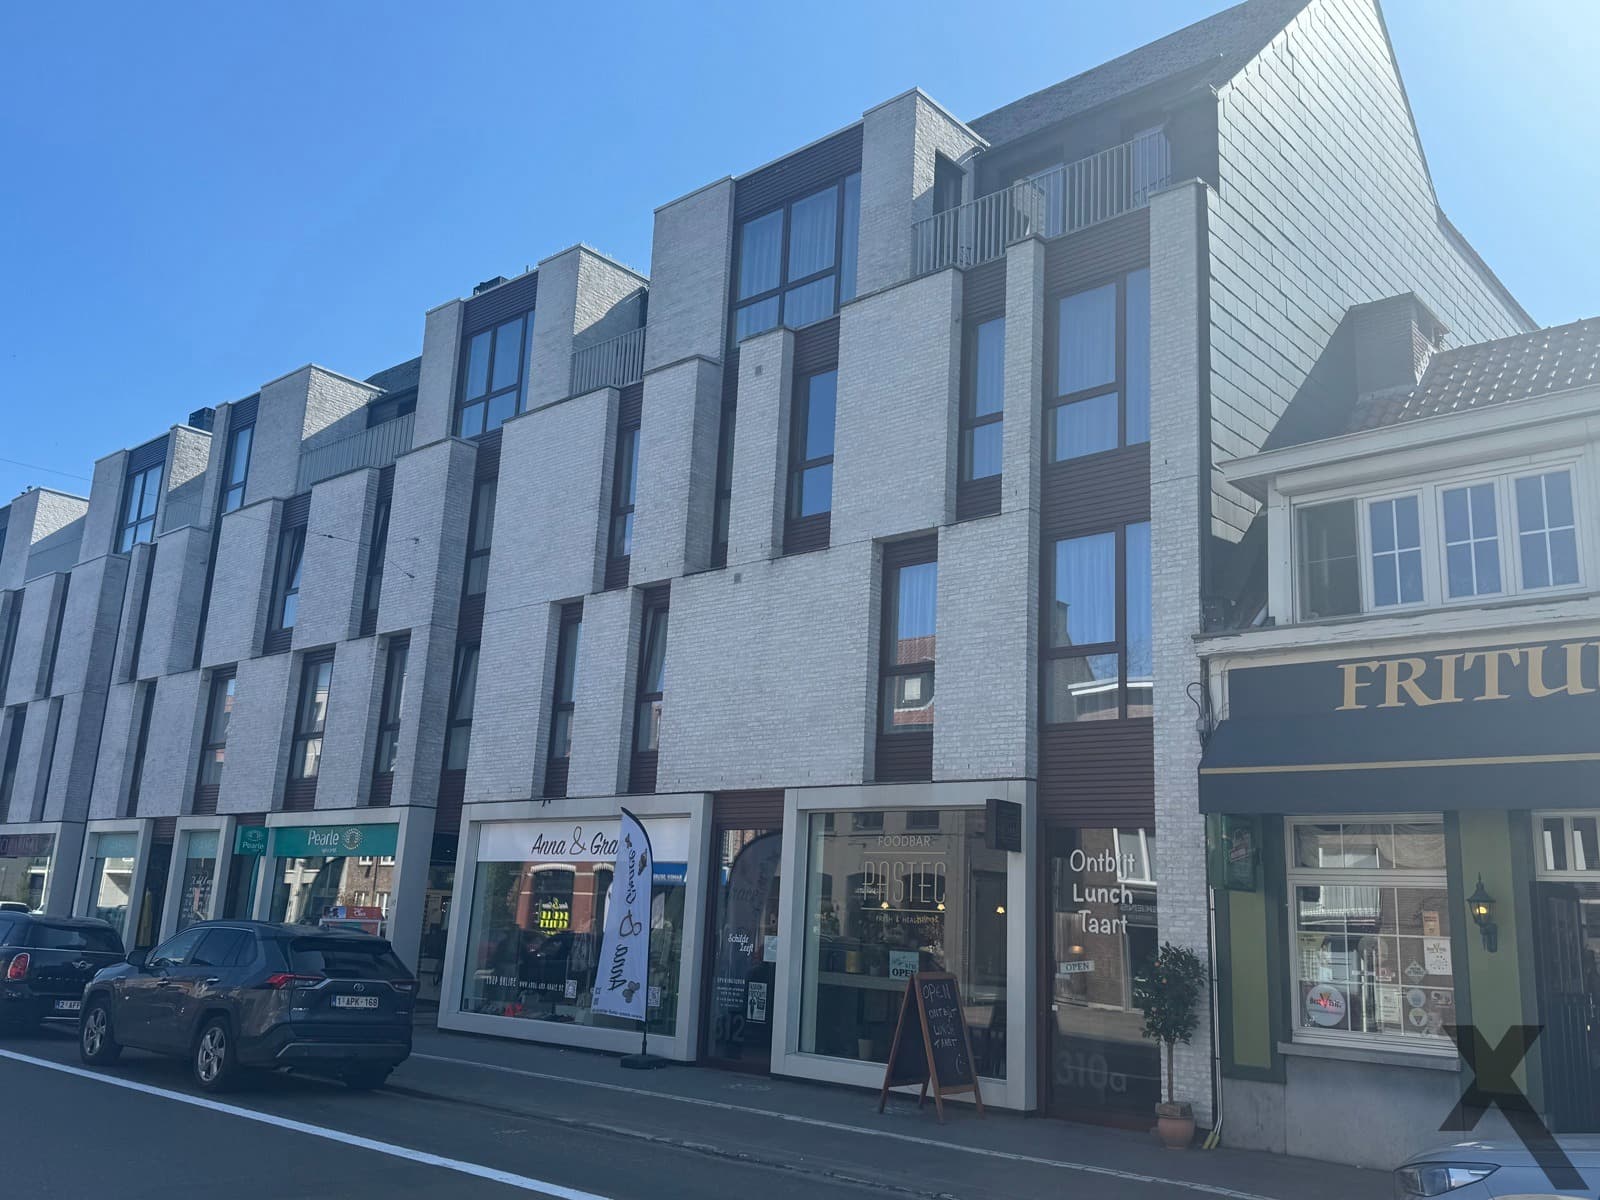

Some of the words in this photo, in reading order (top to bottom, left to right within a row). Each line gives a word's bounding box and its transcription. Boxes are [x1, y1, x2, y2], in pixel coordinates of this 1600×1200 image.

[1334, 642, 1600, 712] FRITU
[242, 841, 264, 849] Pearle
[307, 830, 340, 846] Pearle
[531, 833, 567, 855] Anna
[569, 826, 587, 855] &
[590, 832, 619, 855] Gra
[878, 835, 931, 847] FOODBAR
[1070, 848, 1135, 880] Ontbijt
[861, 861, 946, 904] PASTEC
[1073, 883, 1133, 904] Lunch
[1078, 909, 1128, 934] Taart
[727, 933, 749, 943] Schilde
[1065, 962, 1089, 971] OPEN
[923, 983, 952, 1003] OPEN
[1056, 1050, 1127, 1093] 310a
